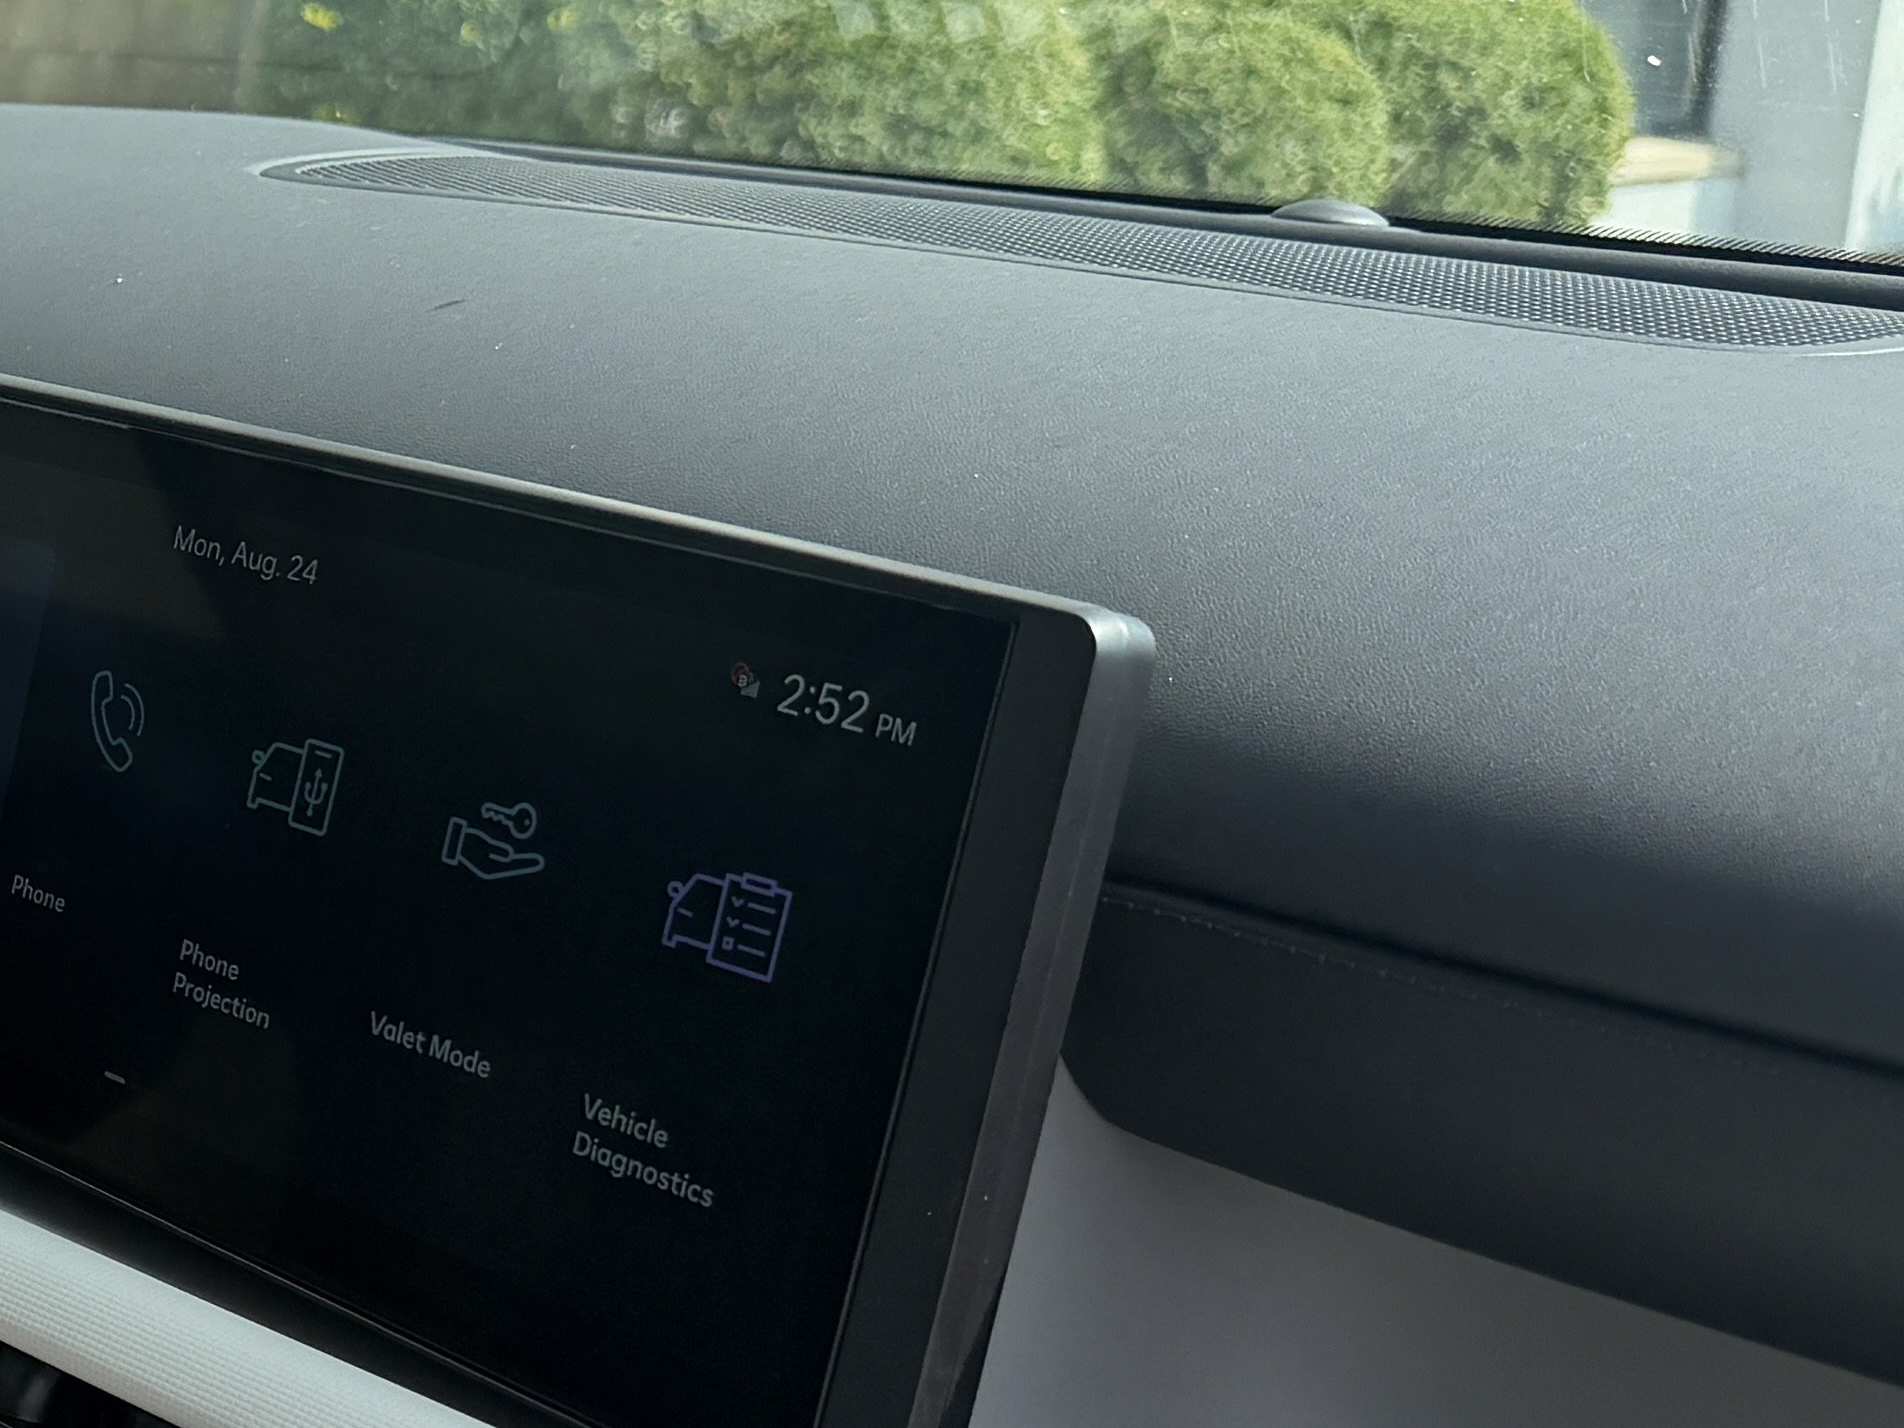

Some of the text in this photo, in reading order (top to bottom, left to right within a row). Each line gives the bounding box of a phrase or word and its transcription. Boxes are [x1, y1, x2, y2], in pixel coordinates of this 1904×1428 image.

[173, 526, 319, 586] Mon, Aug. 24
[777, 674, 918, 747] 2:52 PM
[11, 874, 67, 914] Phone
[179, 939, 240, 981] Phone
[173, 967, 270, 1029] Projection
[369, 1011, 492, 1079] Valet Mode
[582, 1092, 670, 1151] Vehicle
[572, 1131, 715, 1209] Diagnostics
